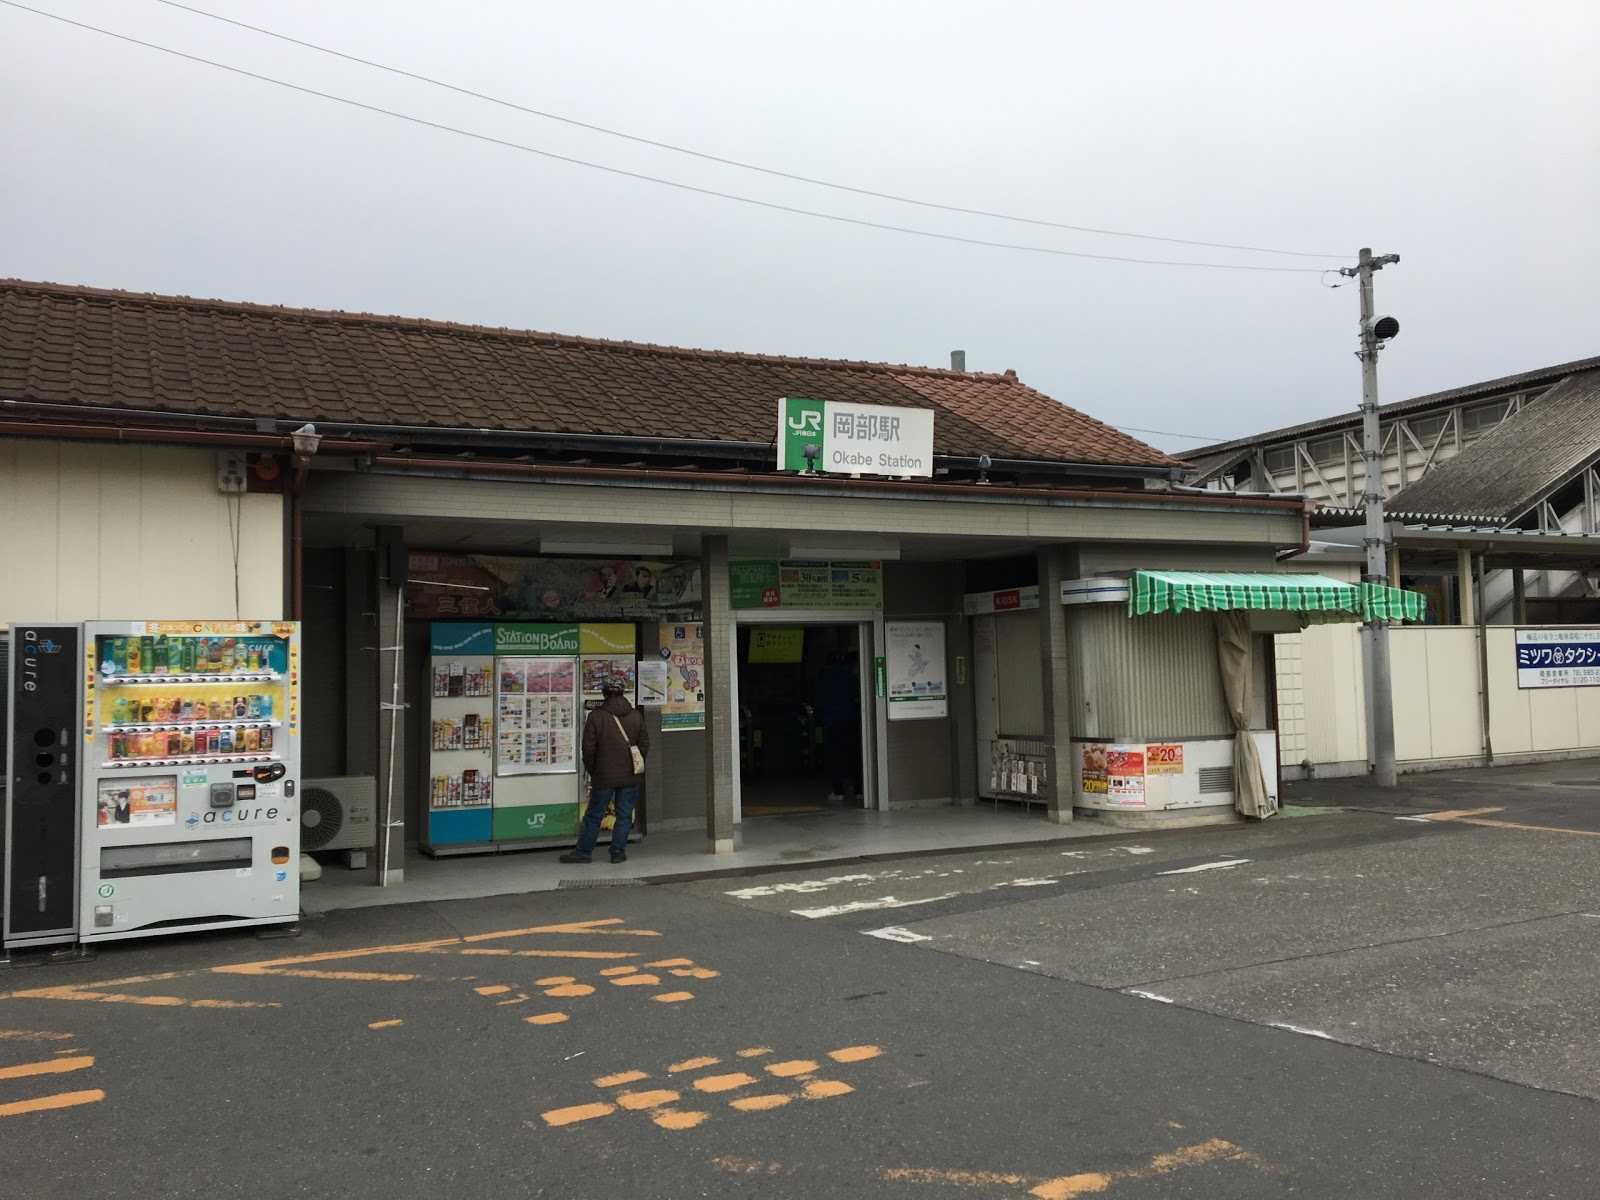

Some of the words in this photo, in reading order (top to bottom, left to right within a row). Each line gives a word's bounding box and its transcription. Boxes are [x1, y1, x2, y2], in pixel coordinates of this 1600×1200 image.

[789, 410, 822, 431] JR
[833, 412, 900, 441] 岡部駅
[832, 450, 873, 466] Okabe
[879, 453, 922, 469] Station
[24, 630, 38, 693] acure
[1519, 649, 1552, 664] ミツワ
[203, 806, 279, 825] acure
[527, 813, 546, 825] JR
